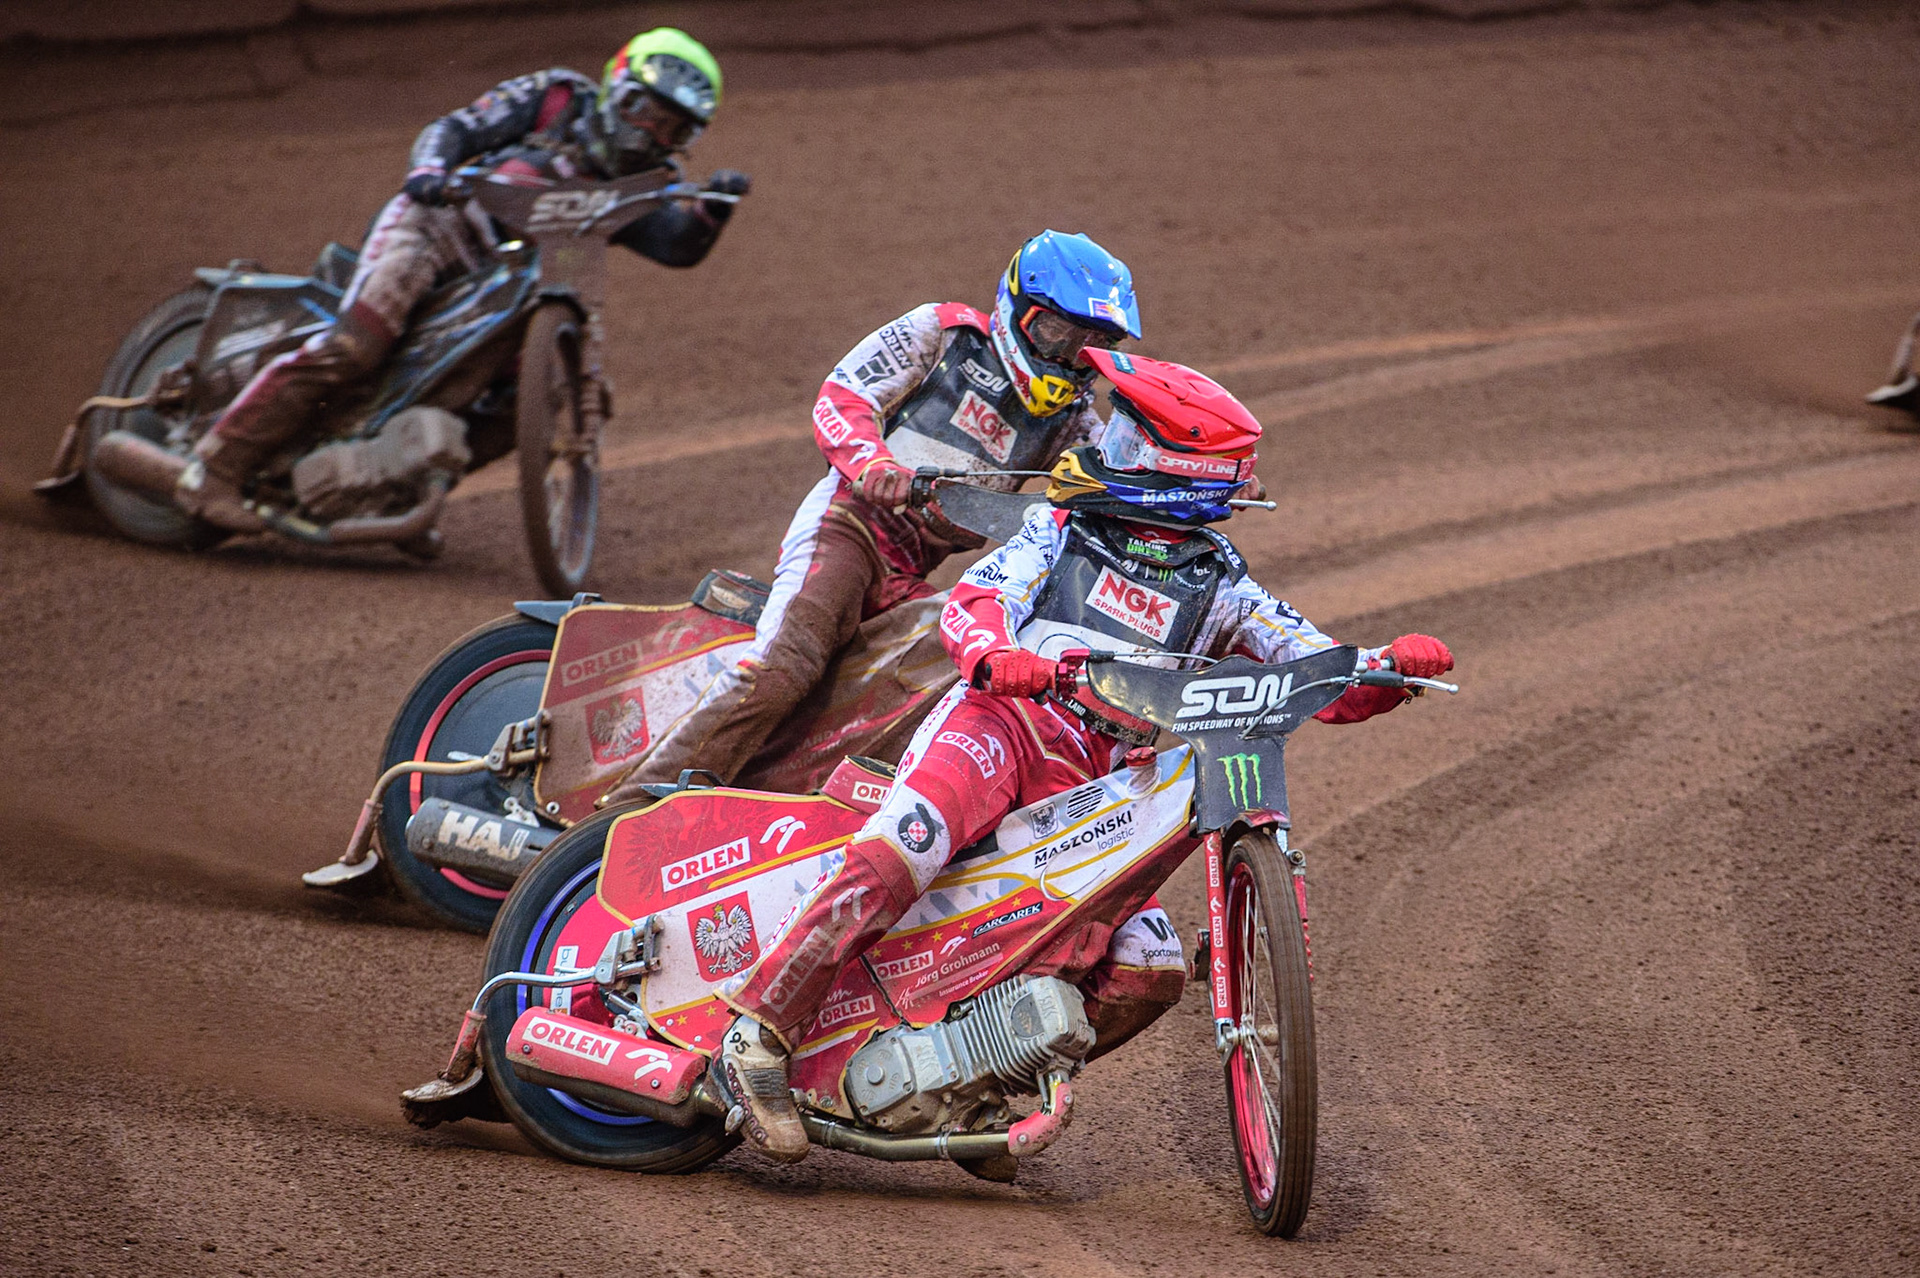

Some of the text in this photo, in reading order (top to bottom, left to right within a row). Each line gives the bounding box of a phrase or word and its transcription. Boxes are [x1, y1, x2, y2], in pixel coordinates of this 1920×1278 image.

[880, 327, 914, 369] ORLEN
[815, 401, 847, 441] ORLEN
[962, 396, 1011, 450] NGK
[1094, 598, 1161, 638] SPARK PLUGS
[1099, 573, 1171, 627] NGK
[566, 644, 638, 680] ORLEN
[1171, 722, 1188, 732] FIM
[1188, 718, 1234, 731] SPEEDWAY
[1234, 716, 1247, 728] OF
[942, 733, 993, 776] ORLEN
[899, 832, 919, 851] PZM
[1034, 810, 1132, 869] MASZOŃSKI
[1097, 827, 1135, 851] logistic
[667, 843, 744, 885] ORLEN
[973, 903, 1041, 935] GARCAREK
[877, 954, 931, 977] ORLEN
[915, 942, 1000, 988] Jörg Grohmann
[939, 969, 989, 998] Insurance Broker
[822, 999, 872, 1024] ORLEN
[531, 1022, 612, 1060] ORLEN
